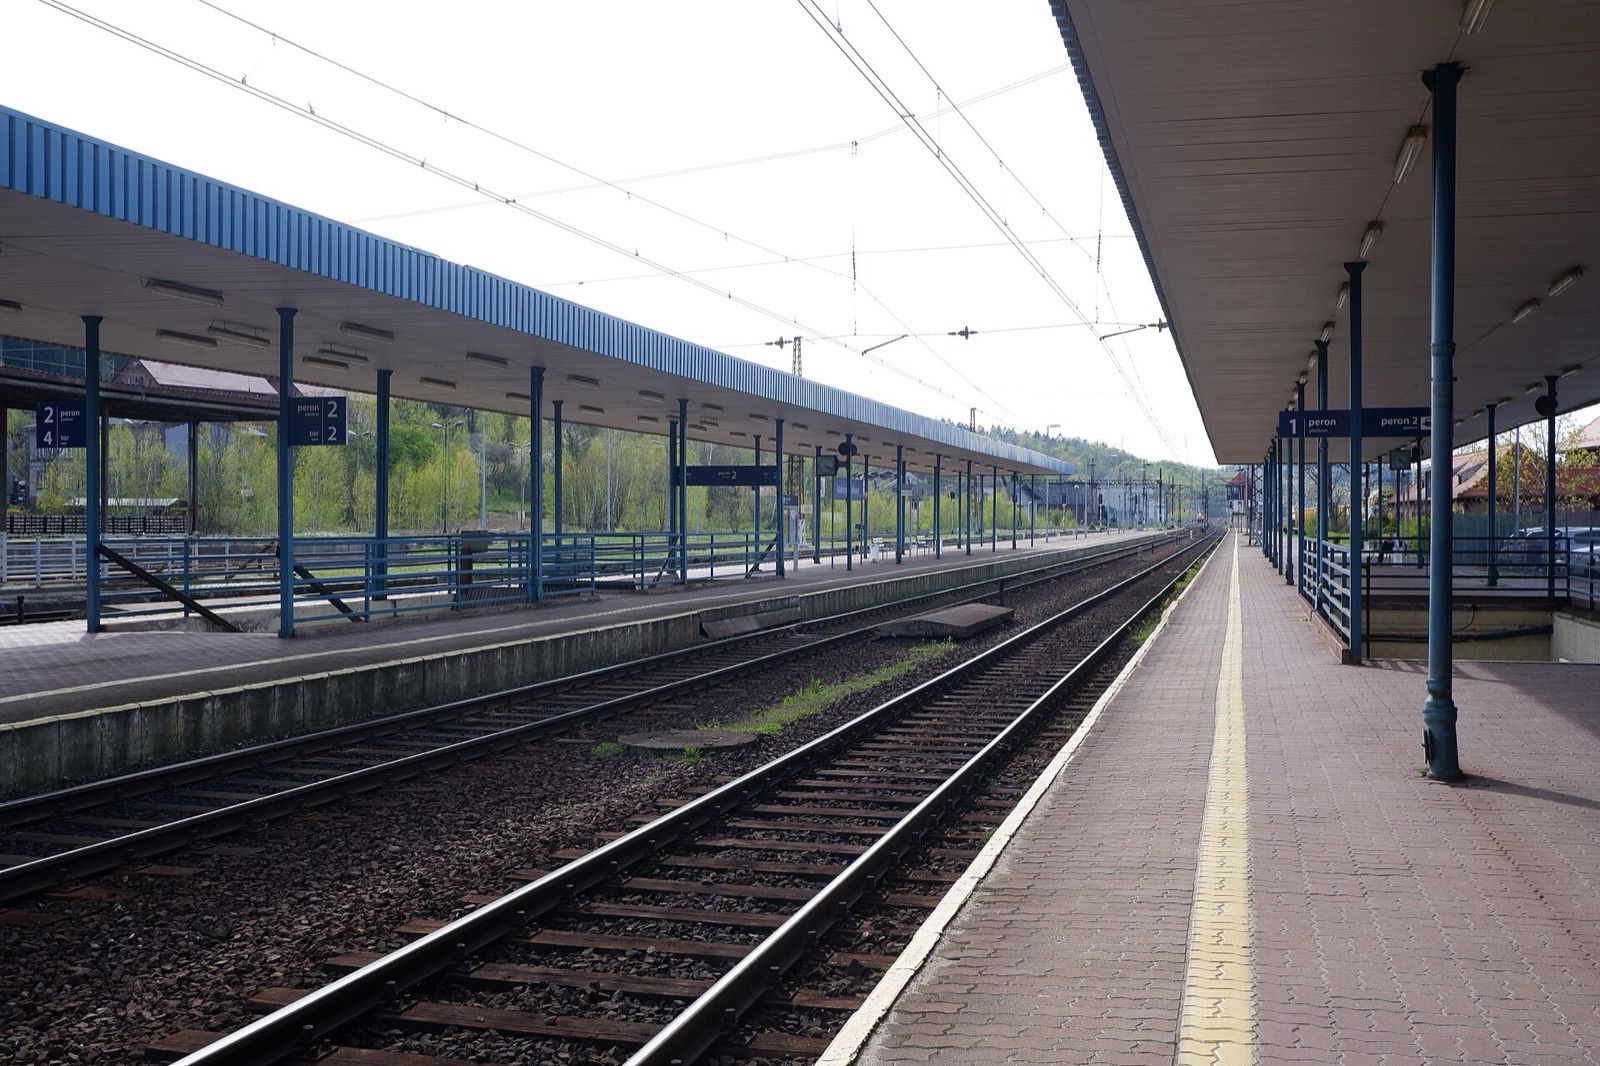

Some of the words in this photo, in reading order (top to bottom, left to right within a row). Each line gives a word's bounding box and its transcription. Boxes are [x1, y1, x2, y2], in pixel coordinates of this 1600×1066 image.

[44, 406, 54, 424] 2
[60, 410, 80, 418] peron
[297, 404, 320, 414] peron
[327, 400, 338, 418] 2
[1289, 418, 1297, 435] 1
[1308, 419, 1336, 428] peron
[1381, 417, 1410, 427] peron
[1412, 416, 1418, 425] 2
[43, 431, 53, 446] 4
[327, 426, 337, 441] 2
[732, 471, 737, 479] 2
